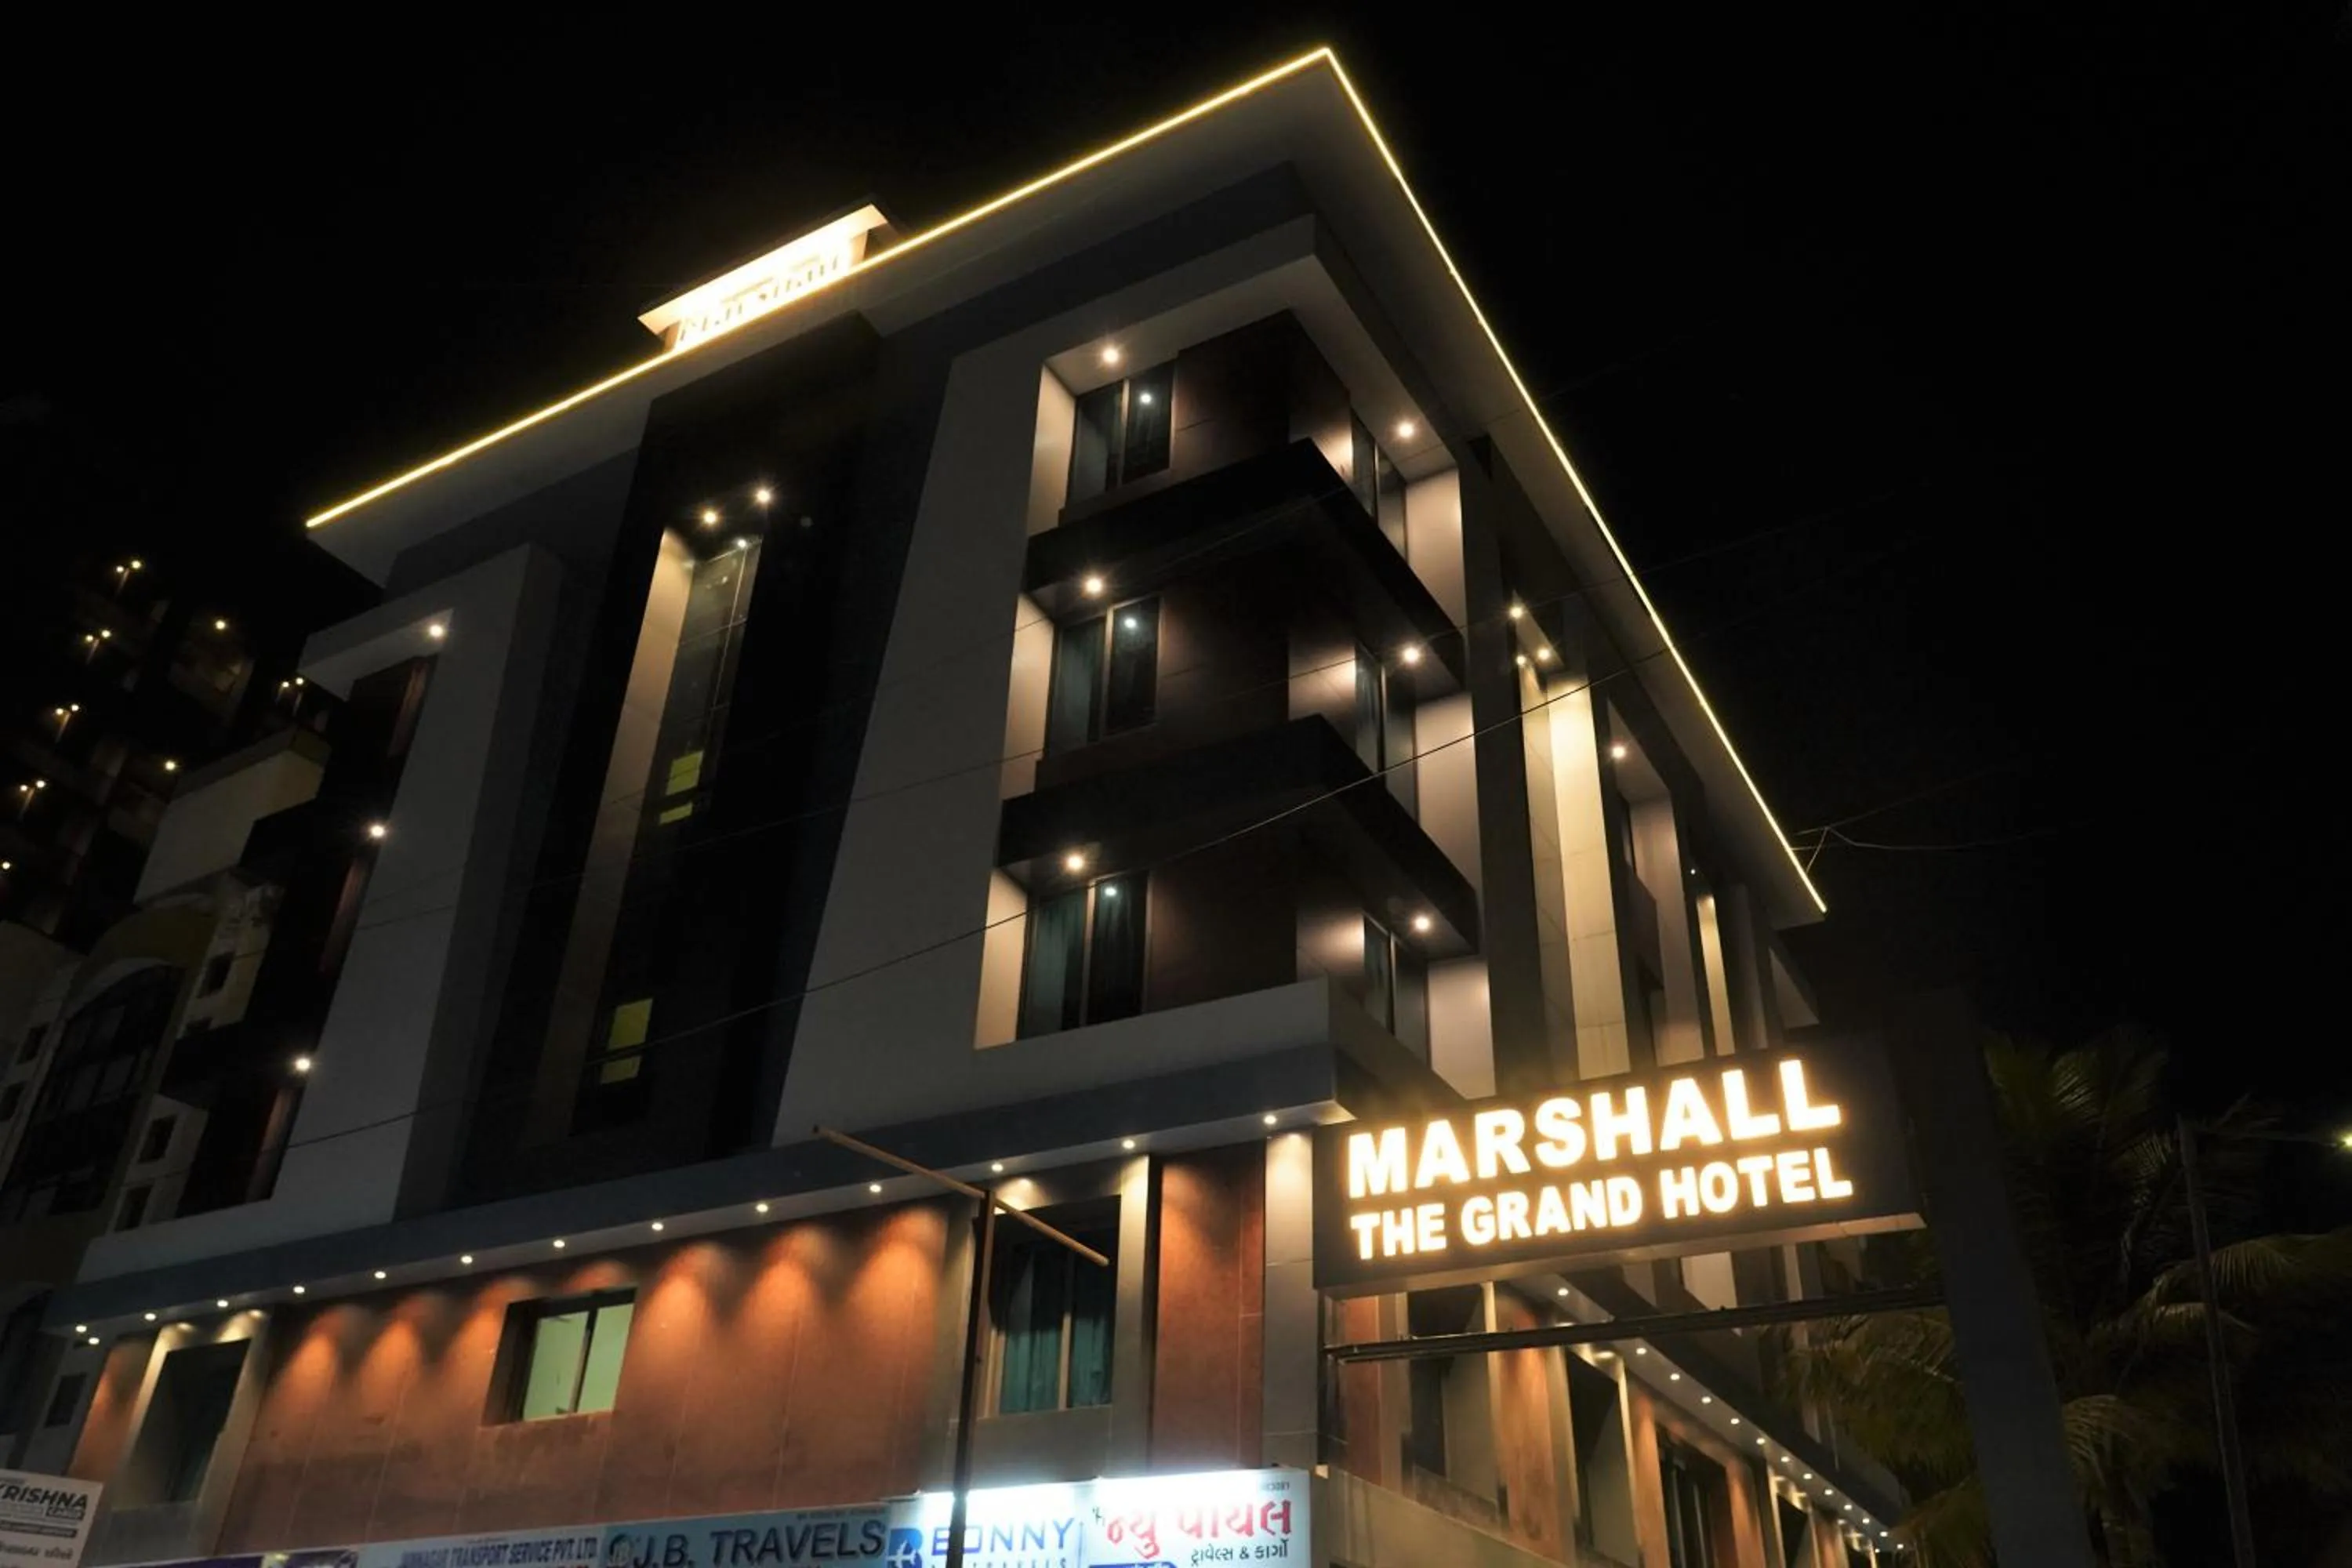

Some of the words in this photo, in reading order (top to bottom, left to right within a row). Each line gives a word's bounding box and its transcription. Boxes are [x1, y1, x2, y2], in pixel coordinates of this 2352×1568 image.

[1348, 1058, 1842, 1199] MARSHALL
[1350, 1203, 1447, 1260] THE
[1461, 1176, 1643, 1246] GRAND
[1661, 1148, 1854, 1219] HOTEL
[0, 1484, 88, 1509] RISHNA
[509, 1540, 554, 1565] SERVICE
[710, 1519, 886, 1566] TRAVELS
[1239, 1546, 1250, 1560] &
